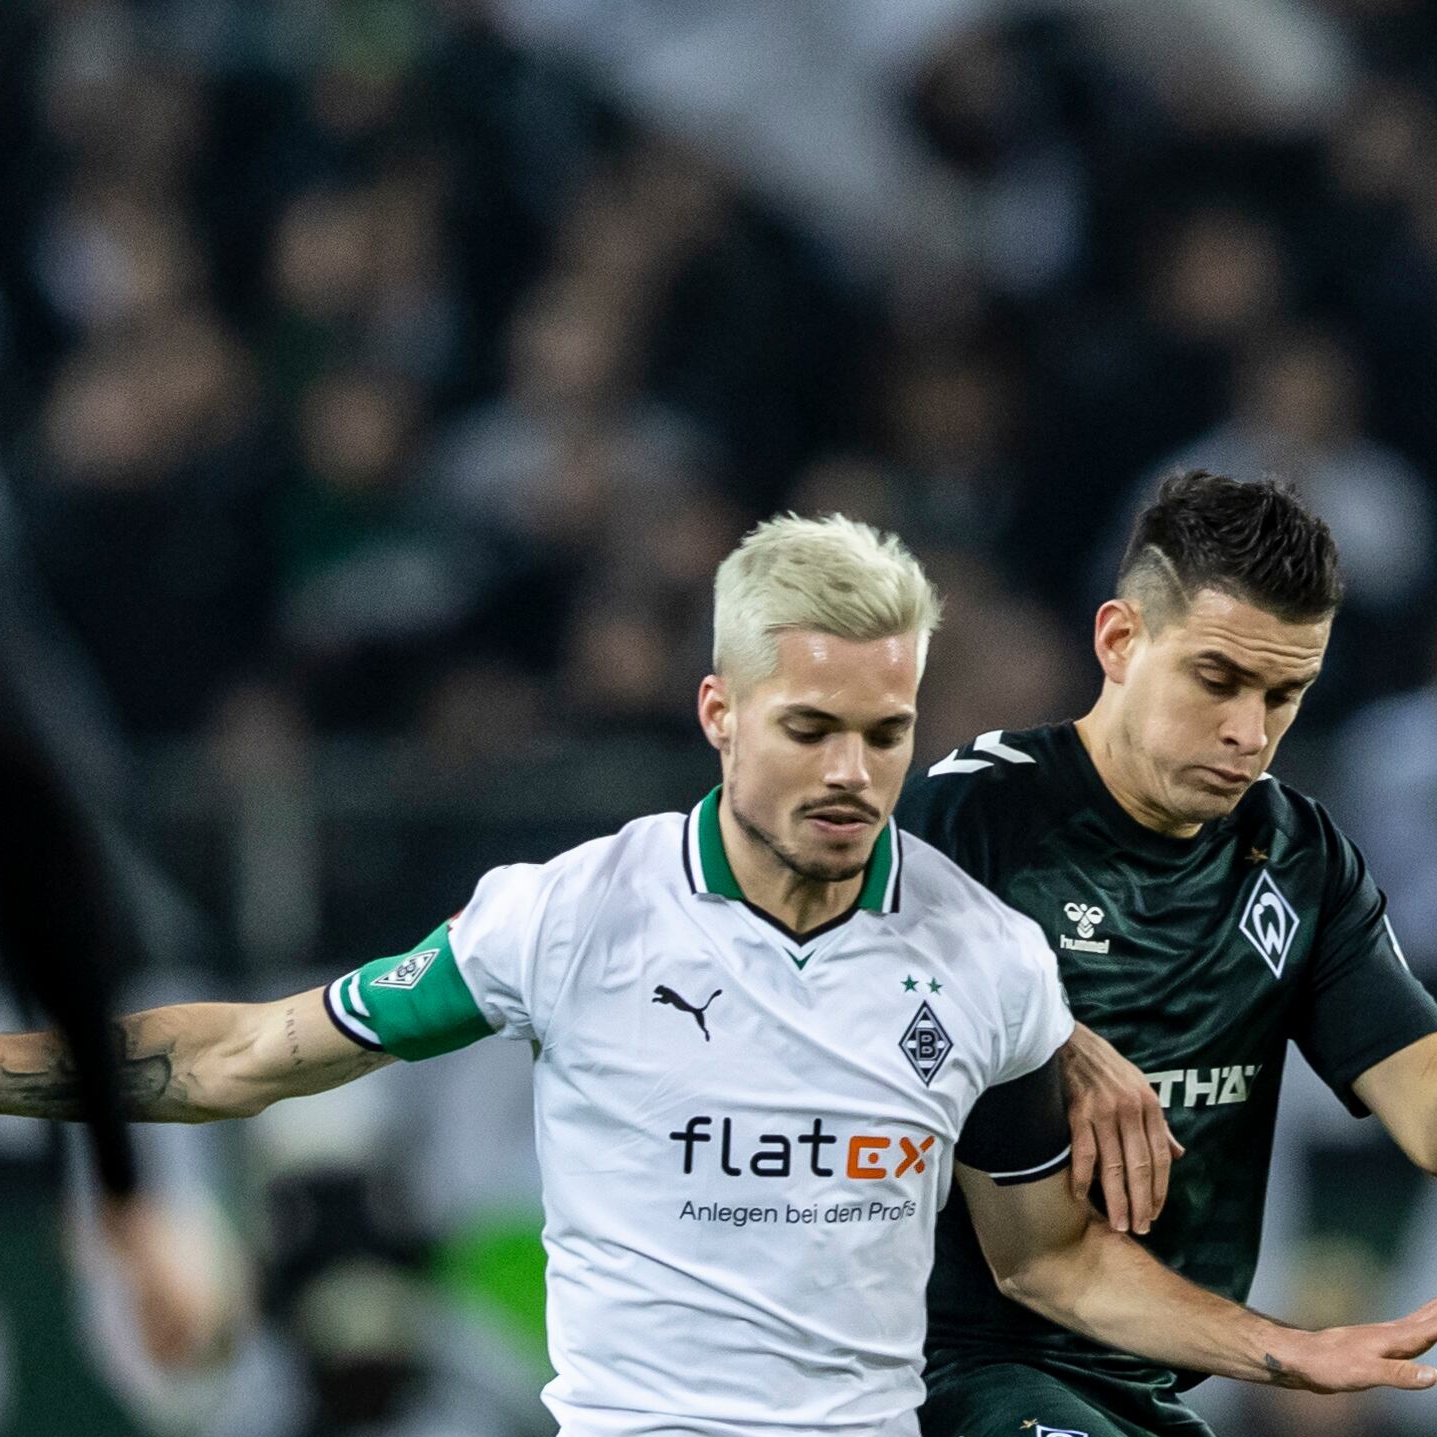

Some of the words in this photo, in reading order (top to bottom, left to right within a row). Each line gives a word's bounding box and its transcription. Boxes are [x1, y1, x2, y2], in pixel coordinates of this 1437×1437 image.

[1143, 1064, 1262, 1109] THÄ
[679, 1201, 777, 1227] Anlegen
[785, 1204, 818, 1224] bei
[824, 1203, 863, 1224] den
